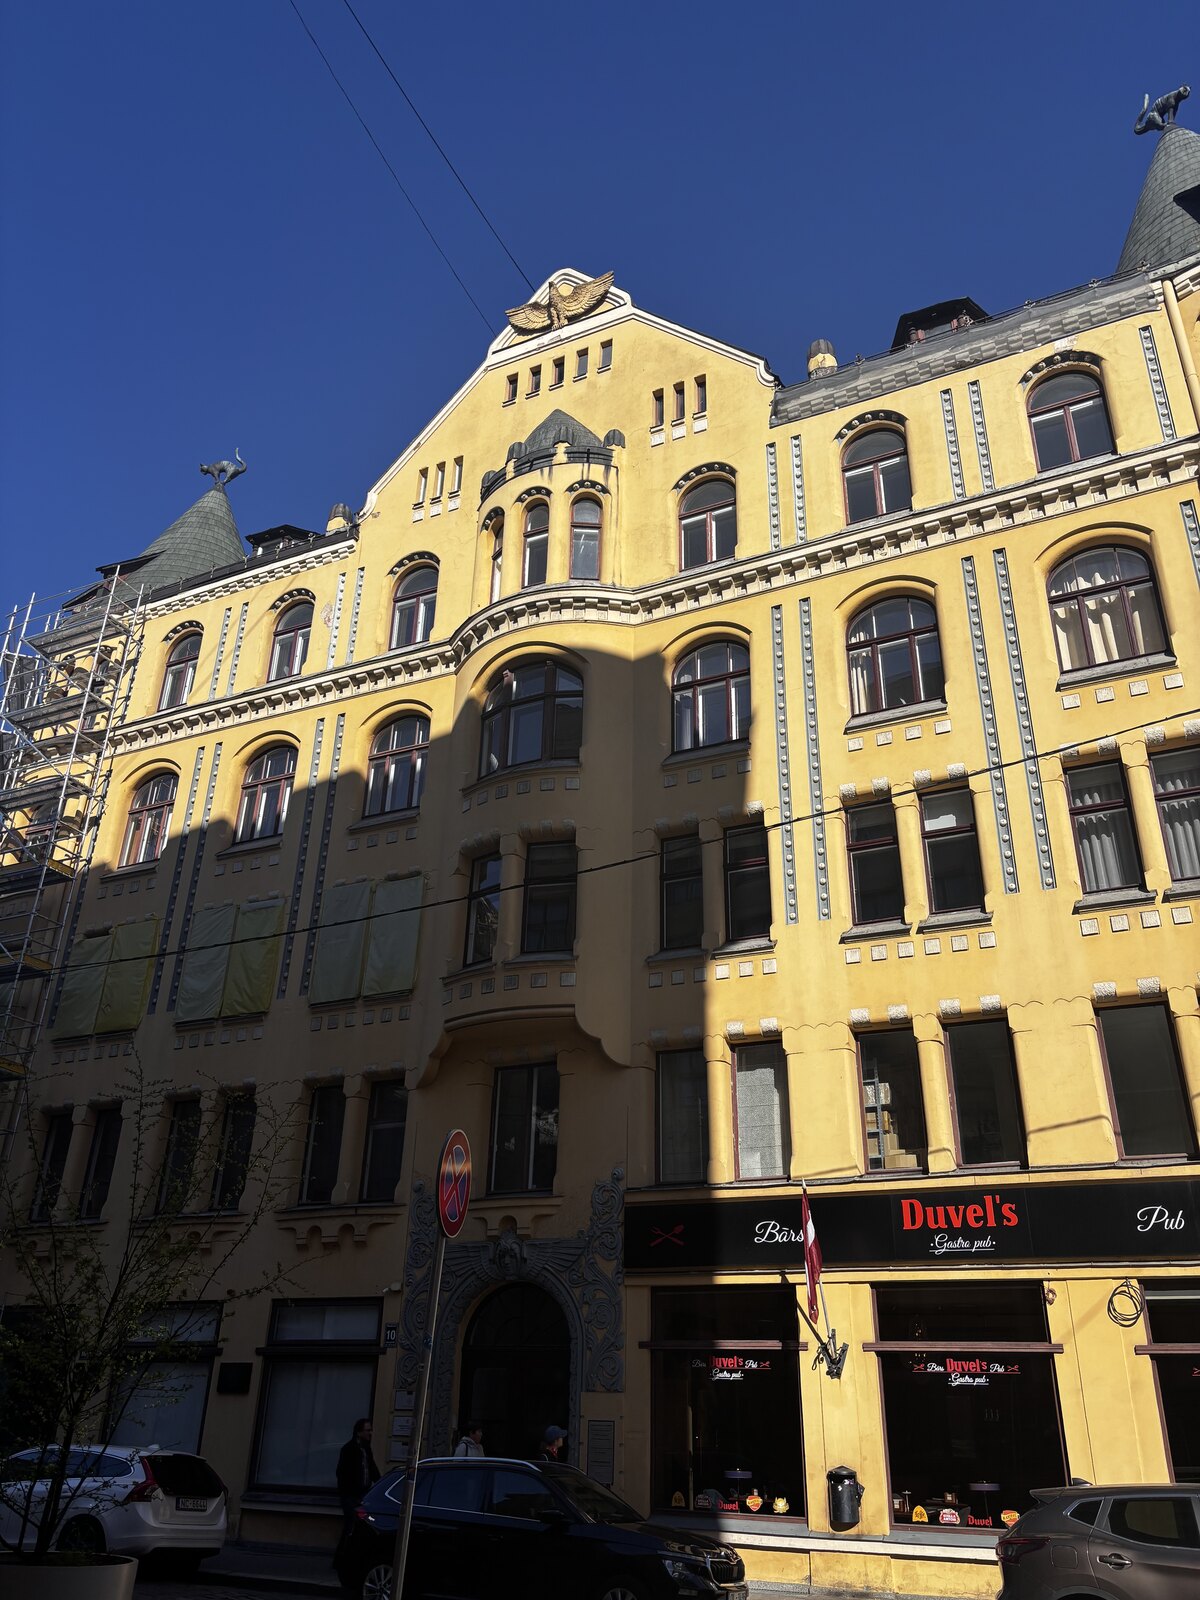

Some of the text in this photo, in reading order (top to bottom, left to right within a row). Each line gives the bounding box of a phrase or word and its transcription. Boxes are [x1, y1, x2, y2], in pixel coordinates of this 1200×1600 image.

[754, 1195, 1185, 1243] Bārs Duvel's Pub
[934, 1234, 992, 1255] Gastro pub
[386, 1330, 396, 1340] 10
[946, 1358, 987, 1372] Duvel's
[989, 1363, 1005, 1373] Pub
[951, 1372, 986, 1386] Gastro pub
[718, 1500, 739, 1510] Duvel
[968, 1515, 992, 1526] Duvel
